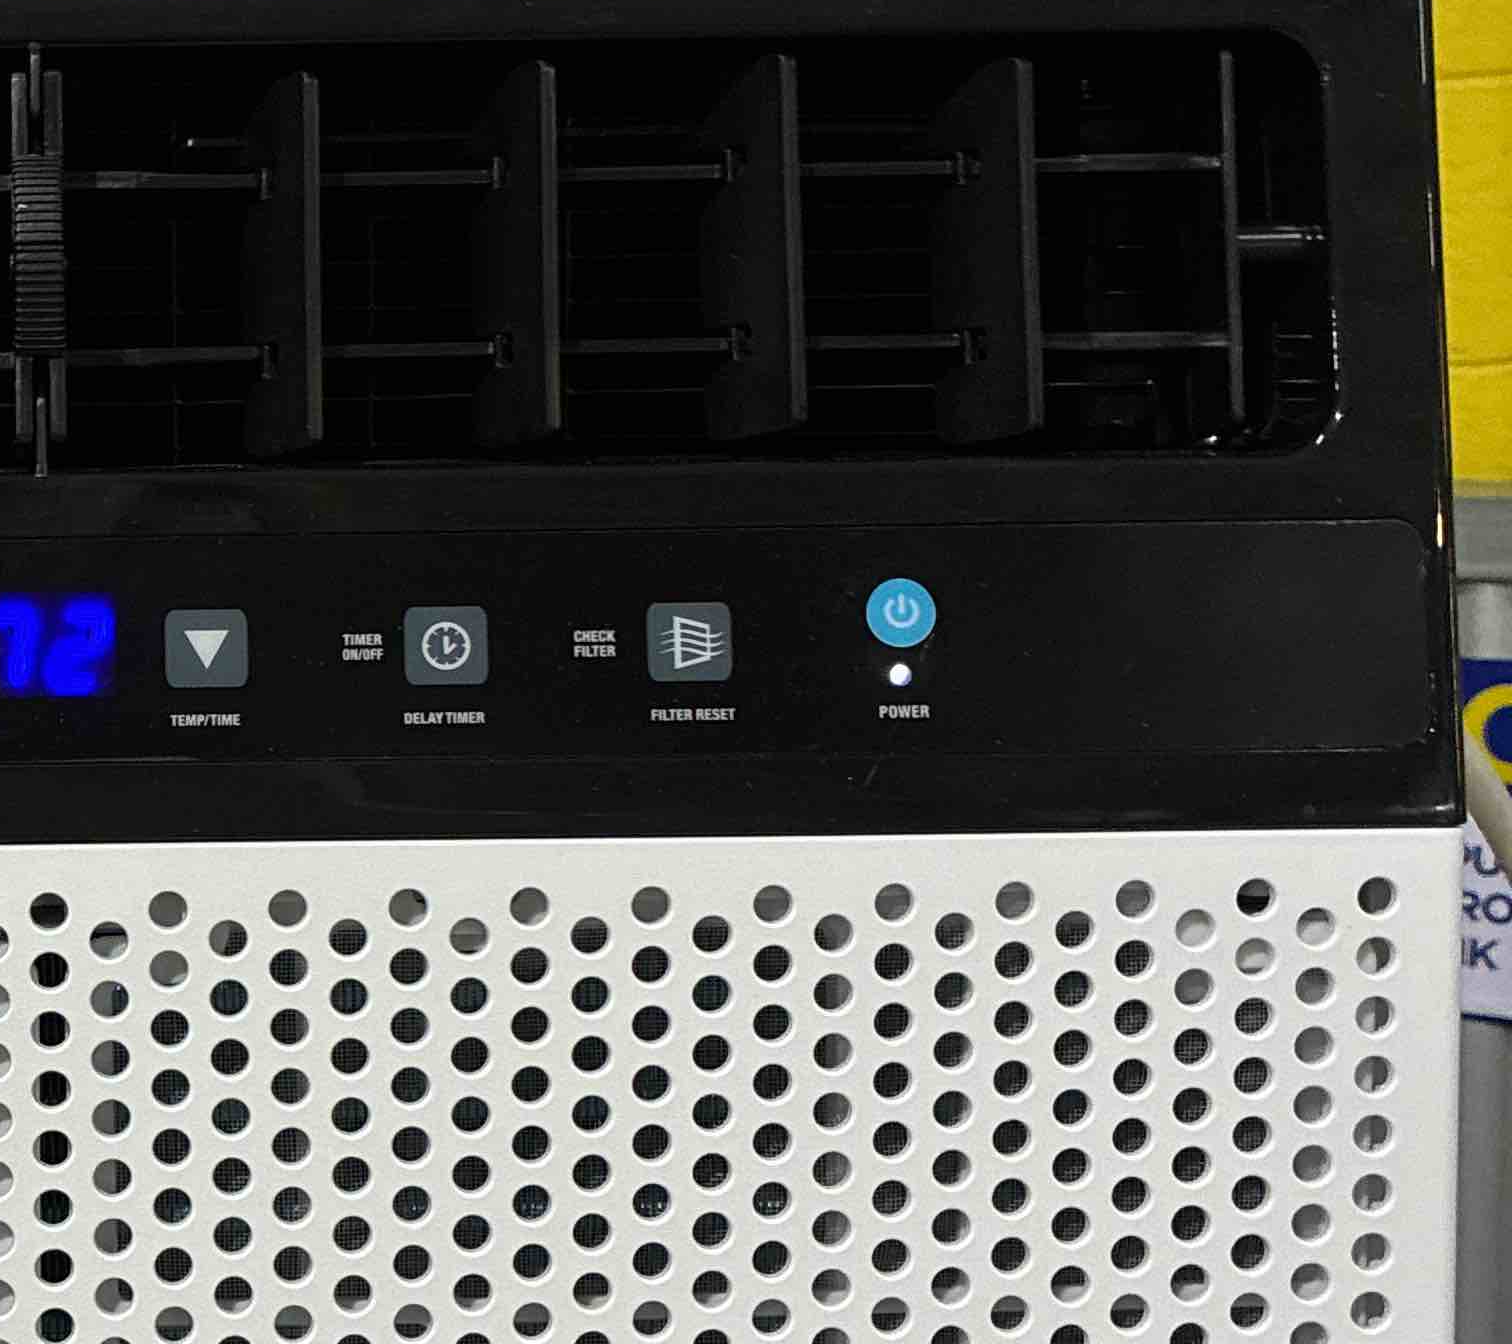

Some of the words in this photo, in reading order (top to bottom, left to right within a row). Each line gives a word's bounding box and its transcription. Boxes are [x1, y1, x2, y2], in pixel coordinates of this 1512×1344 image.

[342, 633, 383, 646] TIMER
[573, 629, 616, 643] CHECK
[342, 647, 384, 661] ON/OFF
[573, 644, 616, 658] FILTER
[403, 711, 444, 725] DELAY
[445, 711, 485, 724] TIMER
[650, 708, 693, 722] FILTER
[695, 707, 736, 721] RESET
[878, 704, 930, 719] POWER
[170, 713, 241, 727] TEMP/TIME
